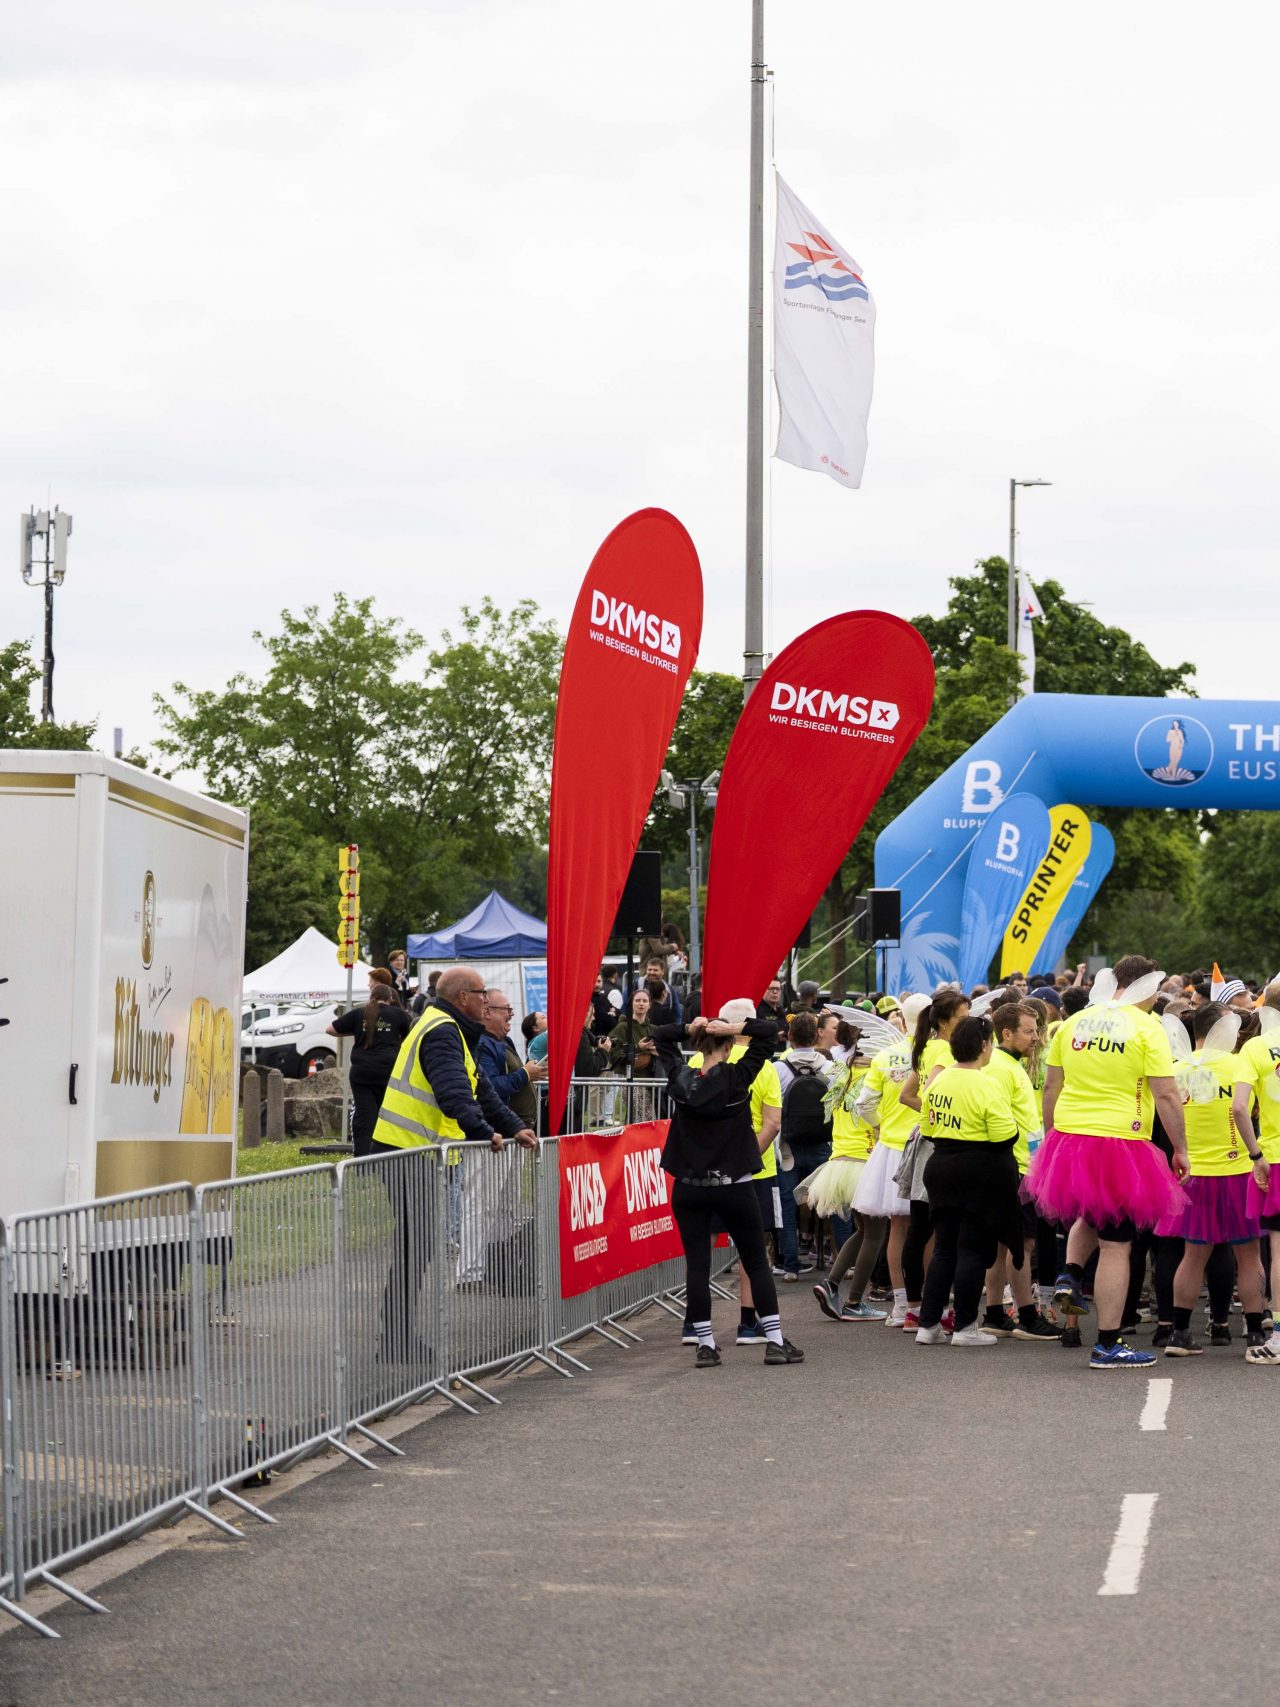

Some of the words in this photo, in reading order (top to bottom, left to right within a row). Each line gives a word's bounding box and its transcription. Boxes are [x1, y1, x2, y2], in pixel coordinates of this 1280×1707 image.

[783, 298, 825, 312] Sportanlage
[854, 315, 866, 324] See
[590, 589, 661, 650] DKMS
[589, 629, 604, 644] WIR
[605, 637, 640, 659] BESIEGEN
[770, 682, 869, 725] DKMS
[769, 714, 788, 725] WIR
[790, 718, 838, 734] BESIEGEN
[841, 727, 895, 744] BLUTKREBS
[961, 760, 1005, 814] B
[995, 821, 1021, 863] B
[984, 858, 1024, 879] BLUPHORIA
[1012, 818, 1080, 944] SPRINTER
[308, 991, 329, 999] Köln
[110, 976, 175, 1104] Bitburger
[1087, 1037, 1126, 1054] FUN
[929, 1093, 953, 1110] RUN
[936, 1112, 962, 1131] FUN
[624, 1149, 659, 1215] DKMS
